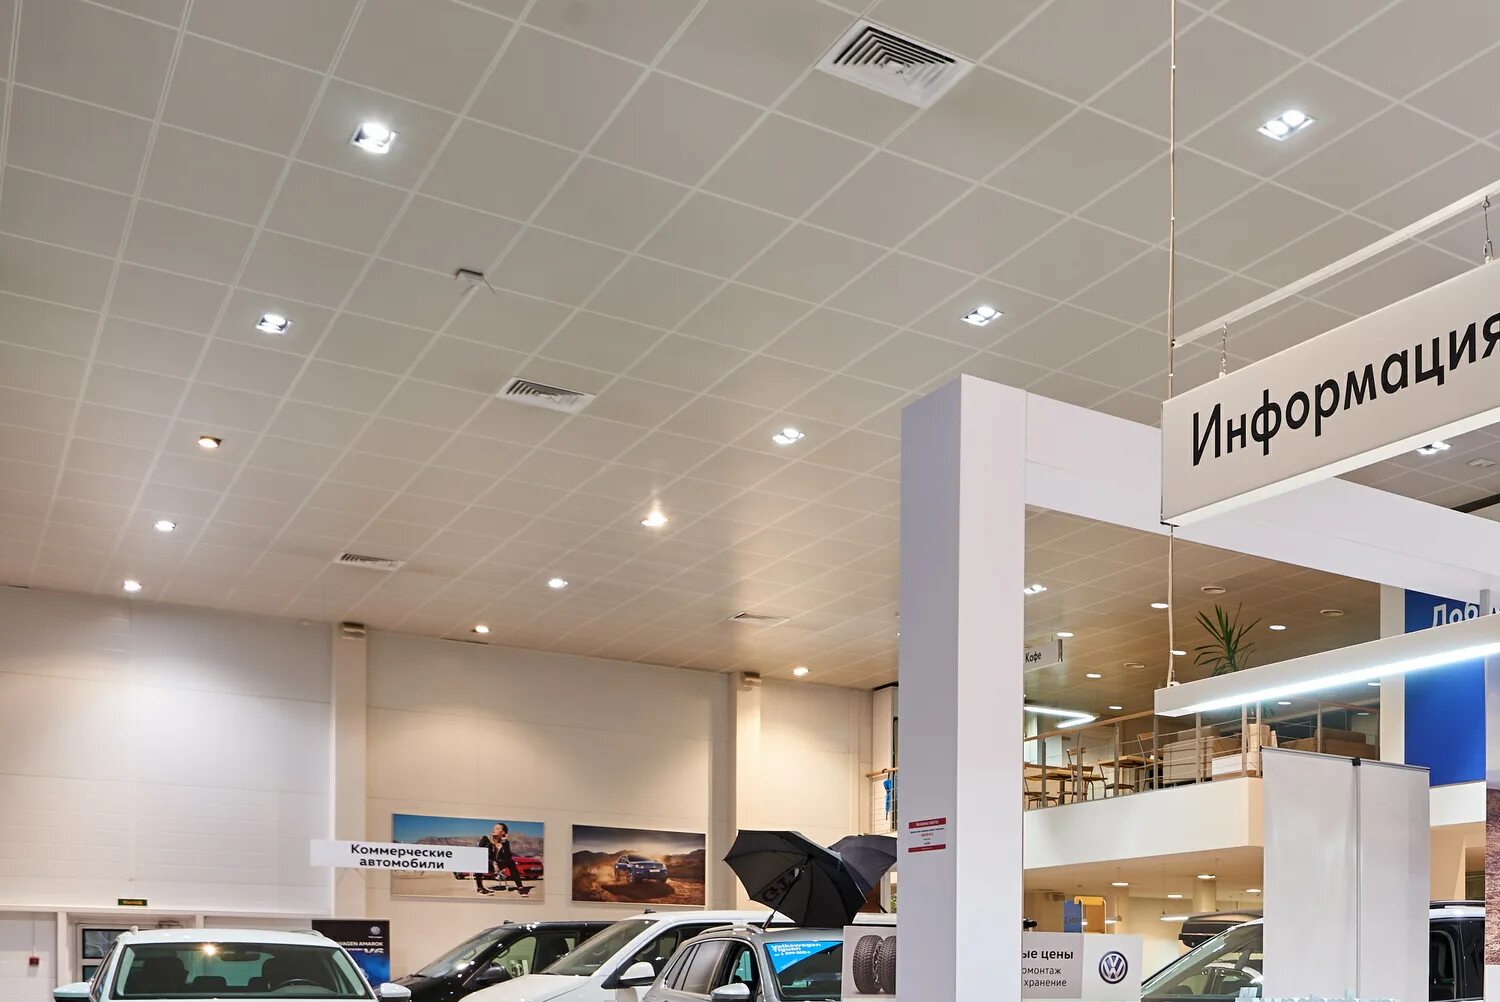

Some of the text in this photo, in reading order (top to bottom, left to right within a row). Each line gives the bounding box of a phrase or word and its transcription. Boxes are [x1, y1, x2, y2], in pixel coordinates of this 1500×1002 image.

[351, 843, 453, 858] Коммерческие
[359, 857, 444, 870] автомобили
[1041, 950, 1074, 962] цены
[1023, 979, 1067, 988] хранение
